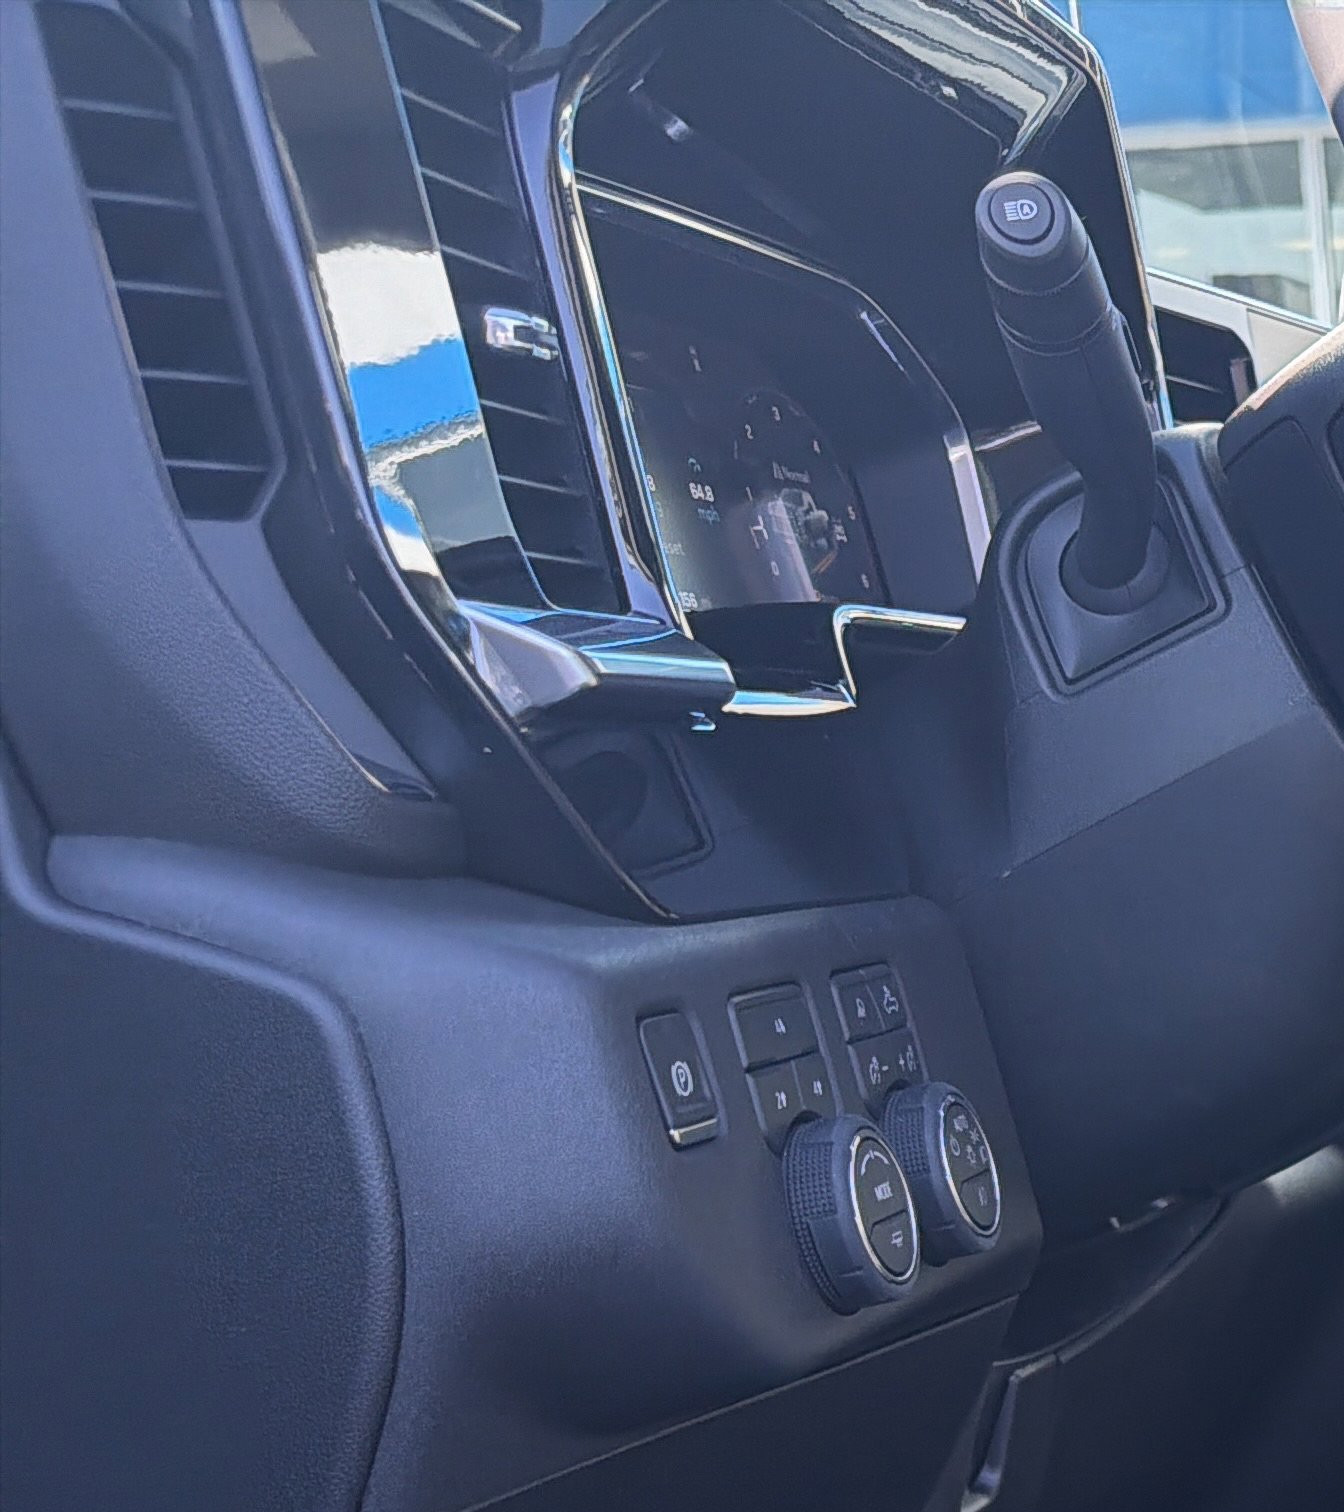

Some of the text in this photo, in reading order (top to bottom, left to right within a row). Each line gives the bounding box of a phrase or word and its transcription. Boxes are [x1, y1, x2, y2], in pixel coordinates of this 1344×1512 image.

[772, 406, 780, 421] 3
[745, 424, 753, 439] 2
[698, 505, 720, 526] mph
